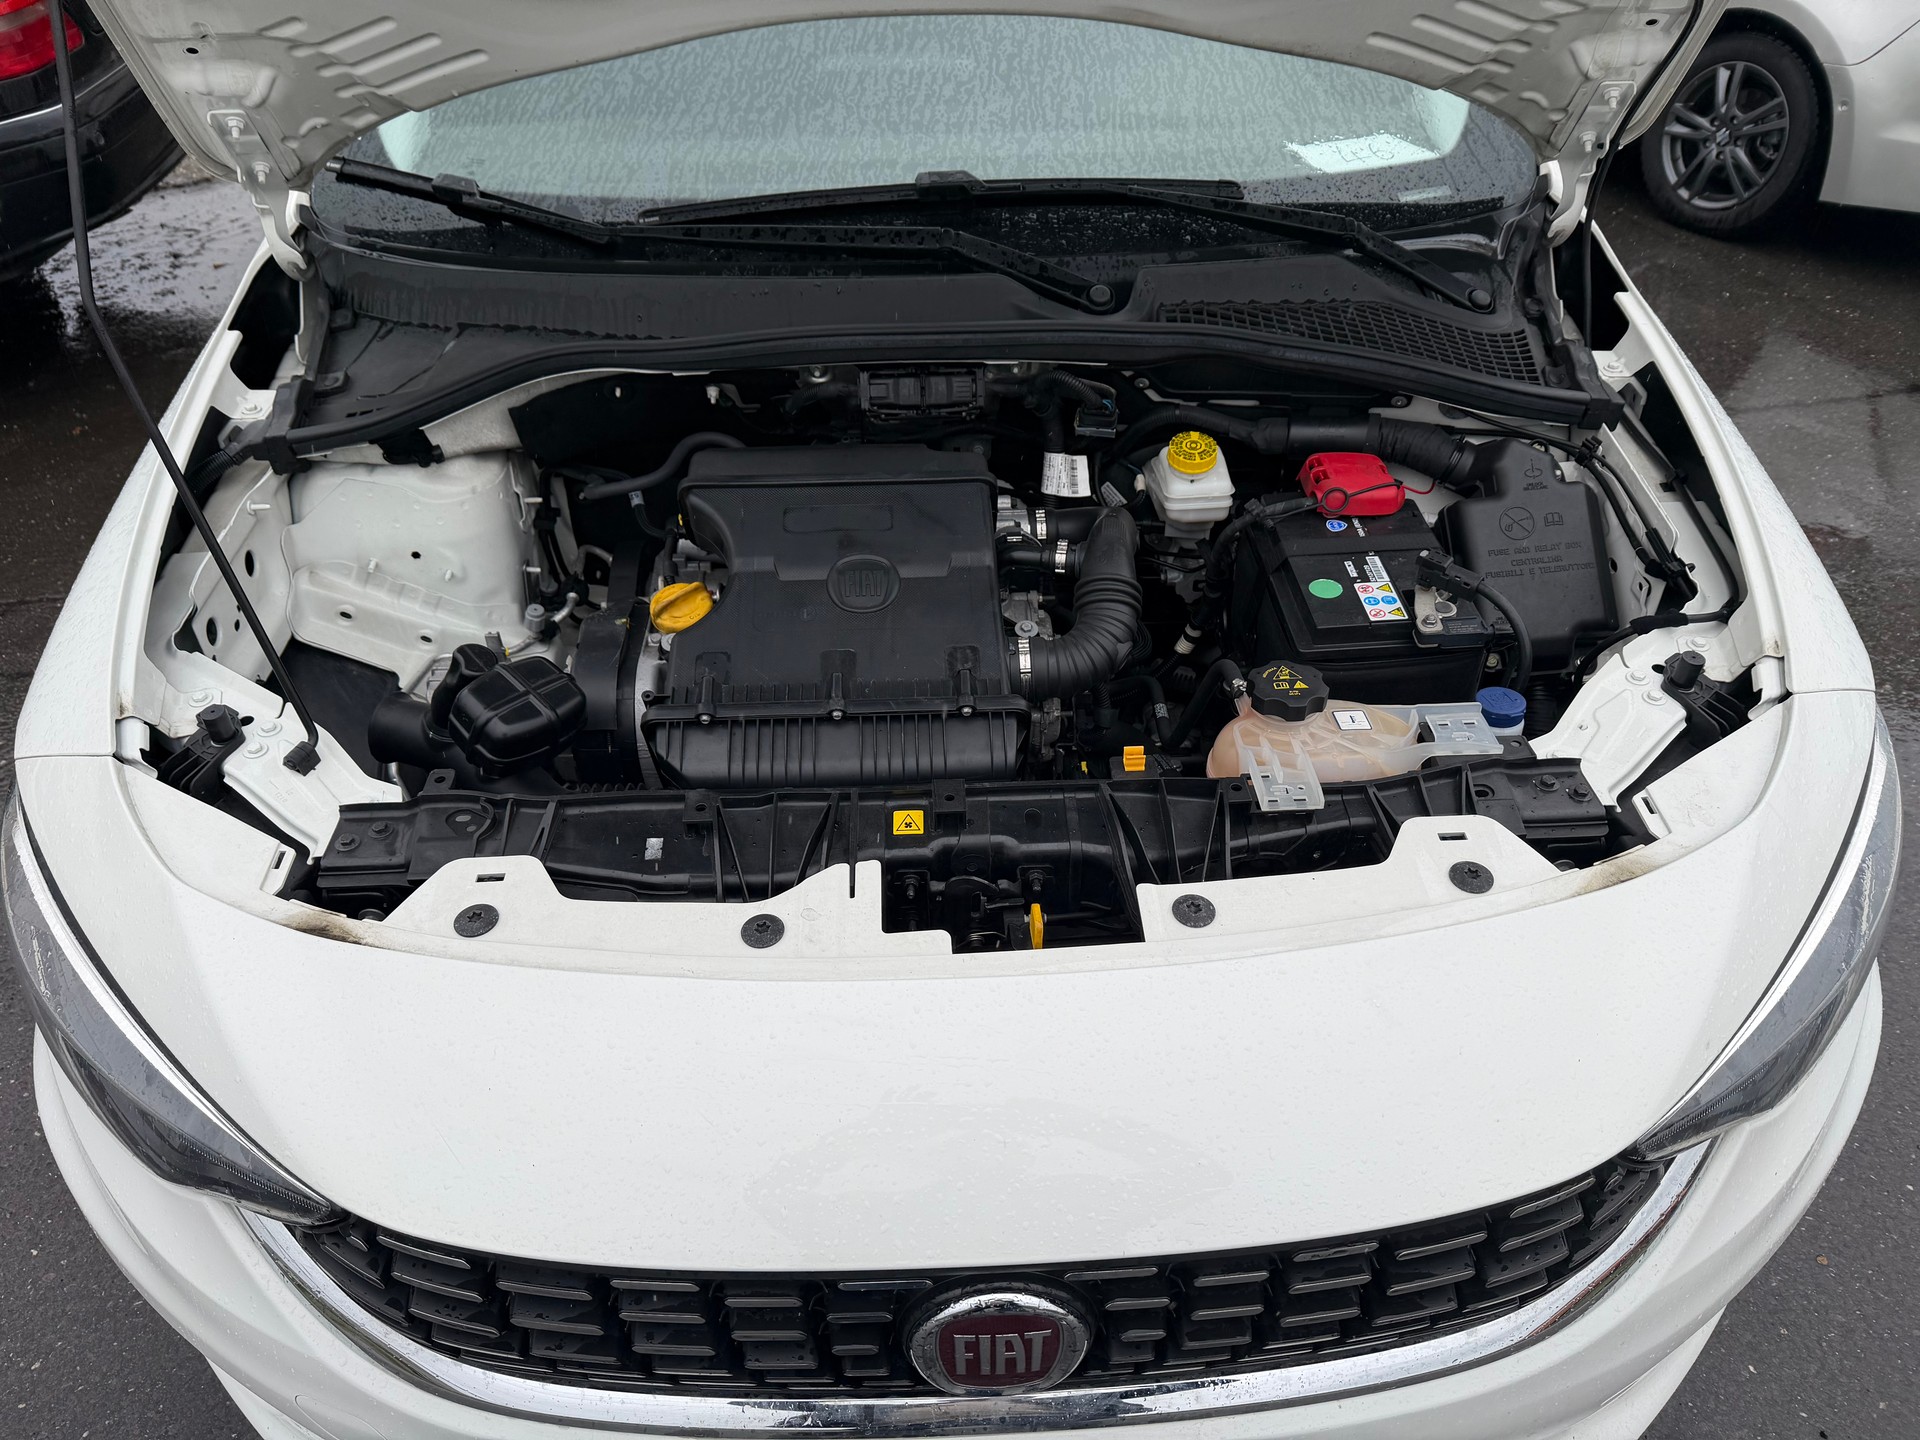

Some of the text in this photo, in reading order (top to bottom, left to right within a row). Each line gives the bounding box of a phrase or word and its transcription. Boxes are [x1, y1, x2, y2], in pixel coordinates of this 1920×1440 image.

[1488, 541, 1582, 557] FUSE AND RELAY BOX
[1510, 555, 1563, 567] CENTRALINA
[843, 568, 887, 598] FIAT
[953, 1329, 1052, 1375] FIAT
